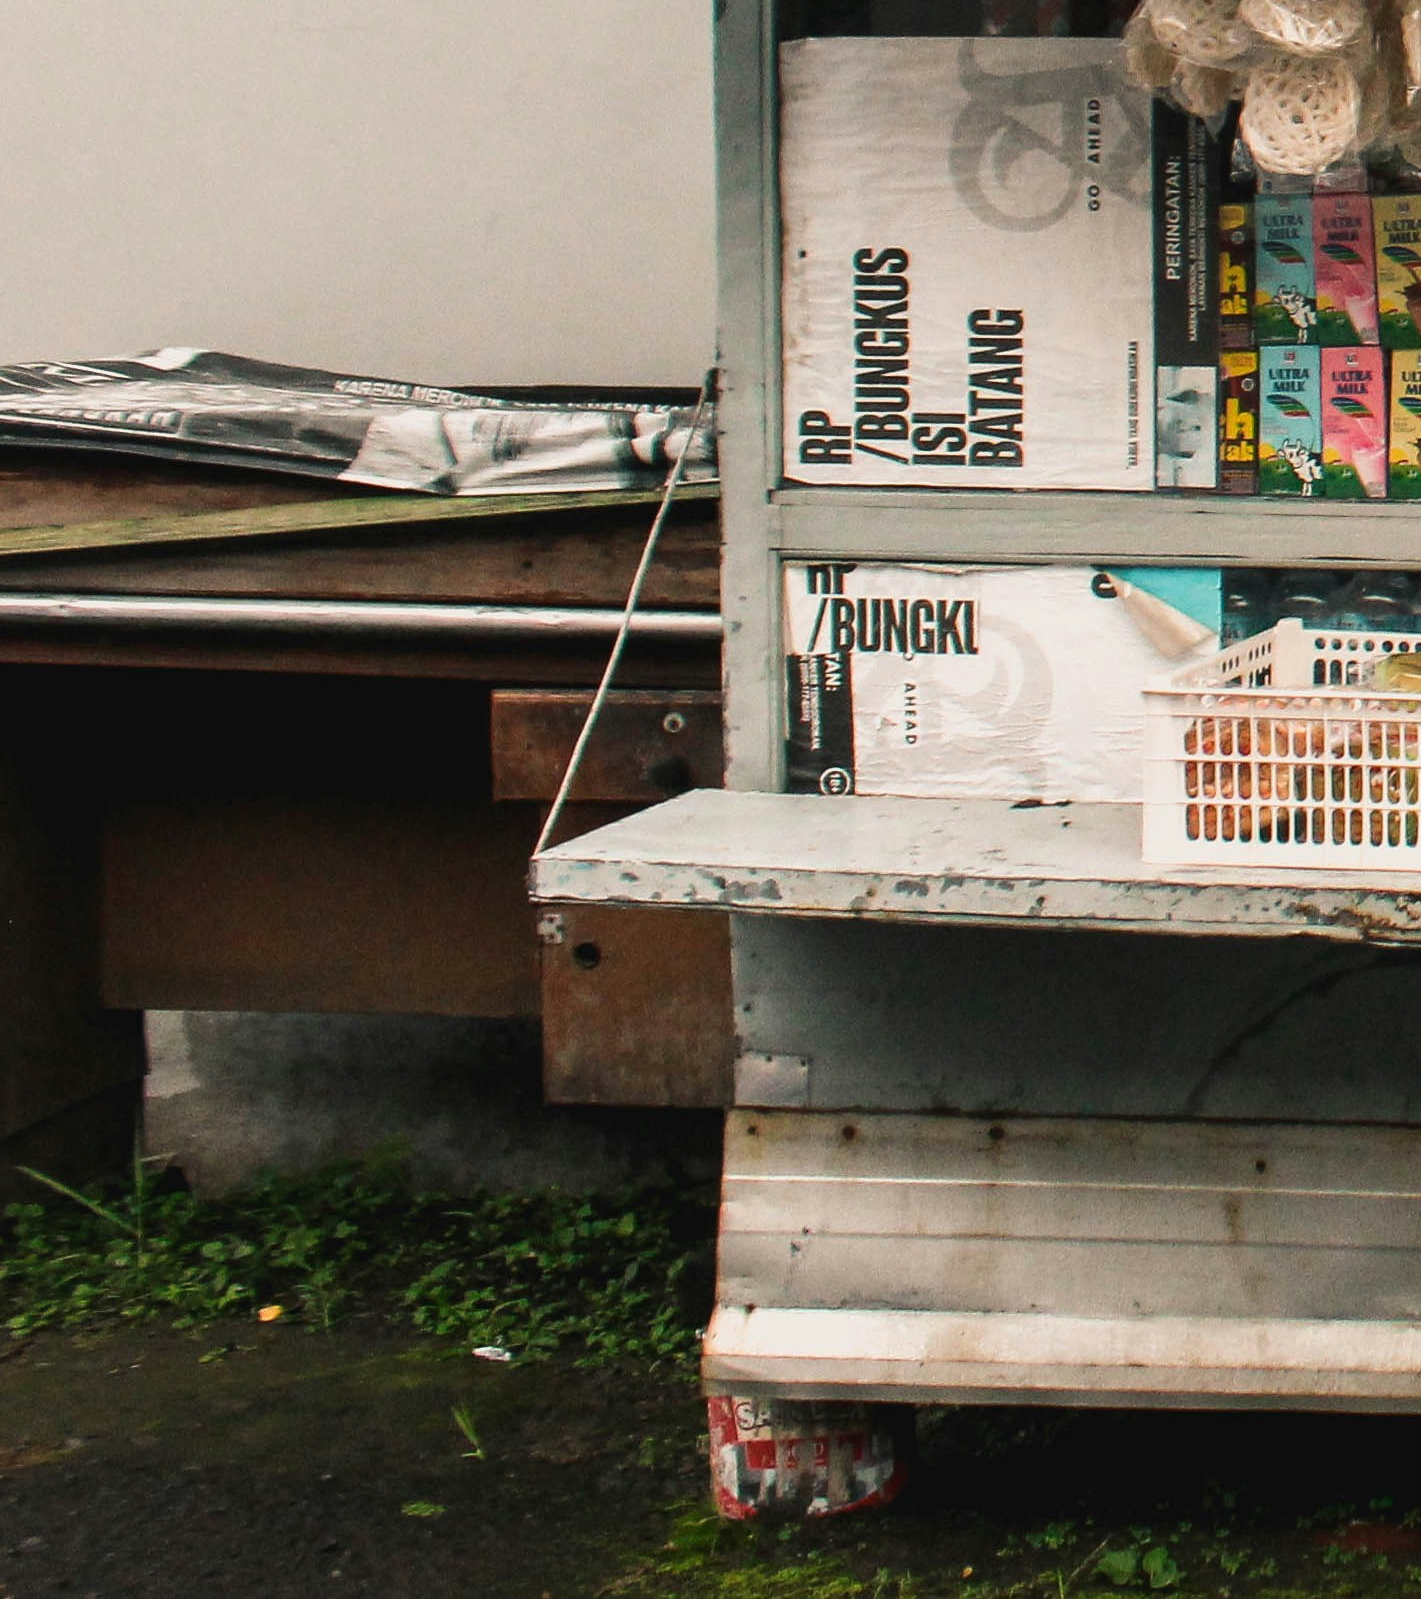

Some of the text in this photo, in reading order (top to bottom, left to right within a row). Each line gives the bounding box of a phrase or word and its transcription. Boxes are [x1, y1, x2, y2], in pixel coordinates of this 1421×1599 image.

[1086, 98, 1101, 212] GO AHEAD
[1165, 155, 1181, 281] PERINGATAN:
[853, 247, 910, 465] /BUNGKUS
[1268, 368, 1310, 380] ULTRA
[1331, 370, 1373, 382] ULTRA
[966, 308, 1025, 468] BATANG
[1272, 379, 1306, 393] MILK
[1336, 382, 1369, 395] MILK
[799, 409, 853, 465] RP
[911, 411, 968, 465] ISI
[903, 682, 918, 746] AHEAD
